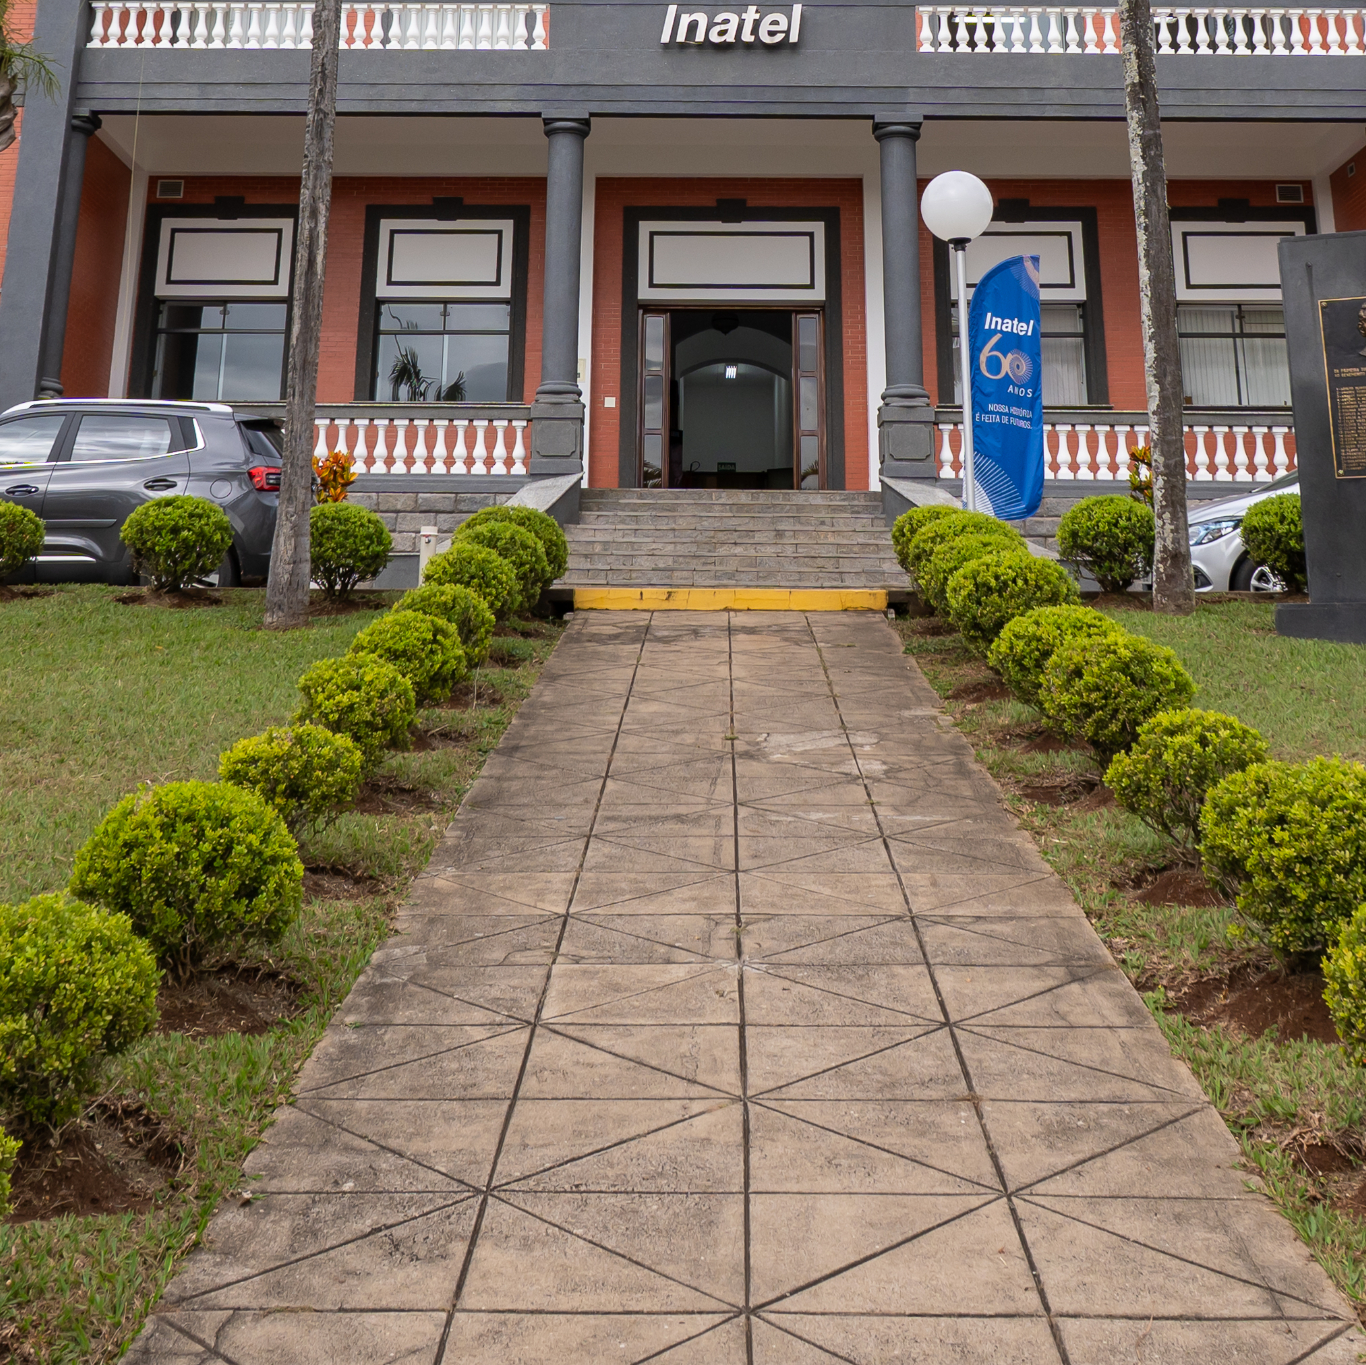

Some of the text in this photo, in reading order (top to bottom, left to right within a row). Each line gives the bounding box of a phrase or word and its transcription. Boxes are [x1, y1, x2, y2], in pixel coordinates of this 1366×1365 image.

[660, 3, 803, 44] Inatel
[984, 312, 1034, 336] Inatel
[979, 333, 1033, 385] 60
[1007, 384, 1033, 398] ANOS
[988, 403, 1009, 413] NOSSA
[975, 411, 980, 422] É
[981, 414, 1001, 423] FEITA
[1001, 415, 1009, 425] DE
